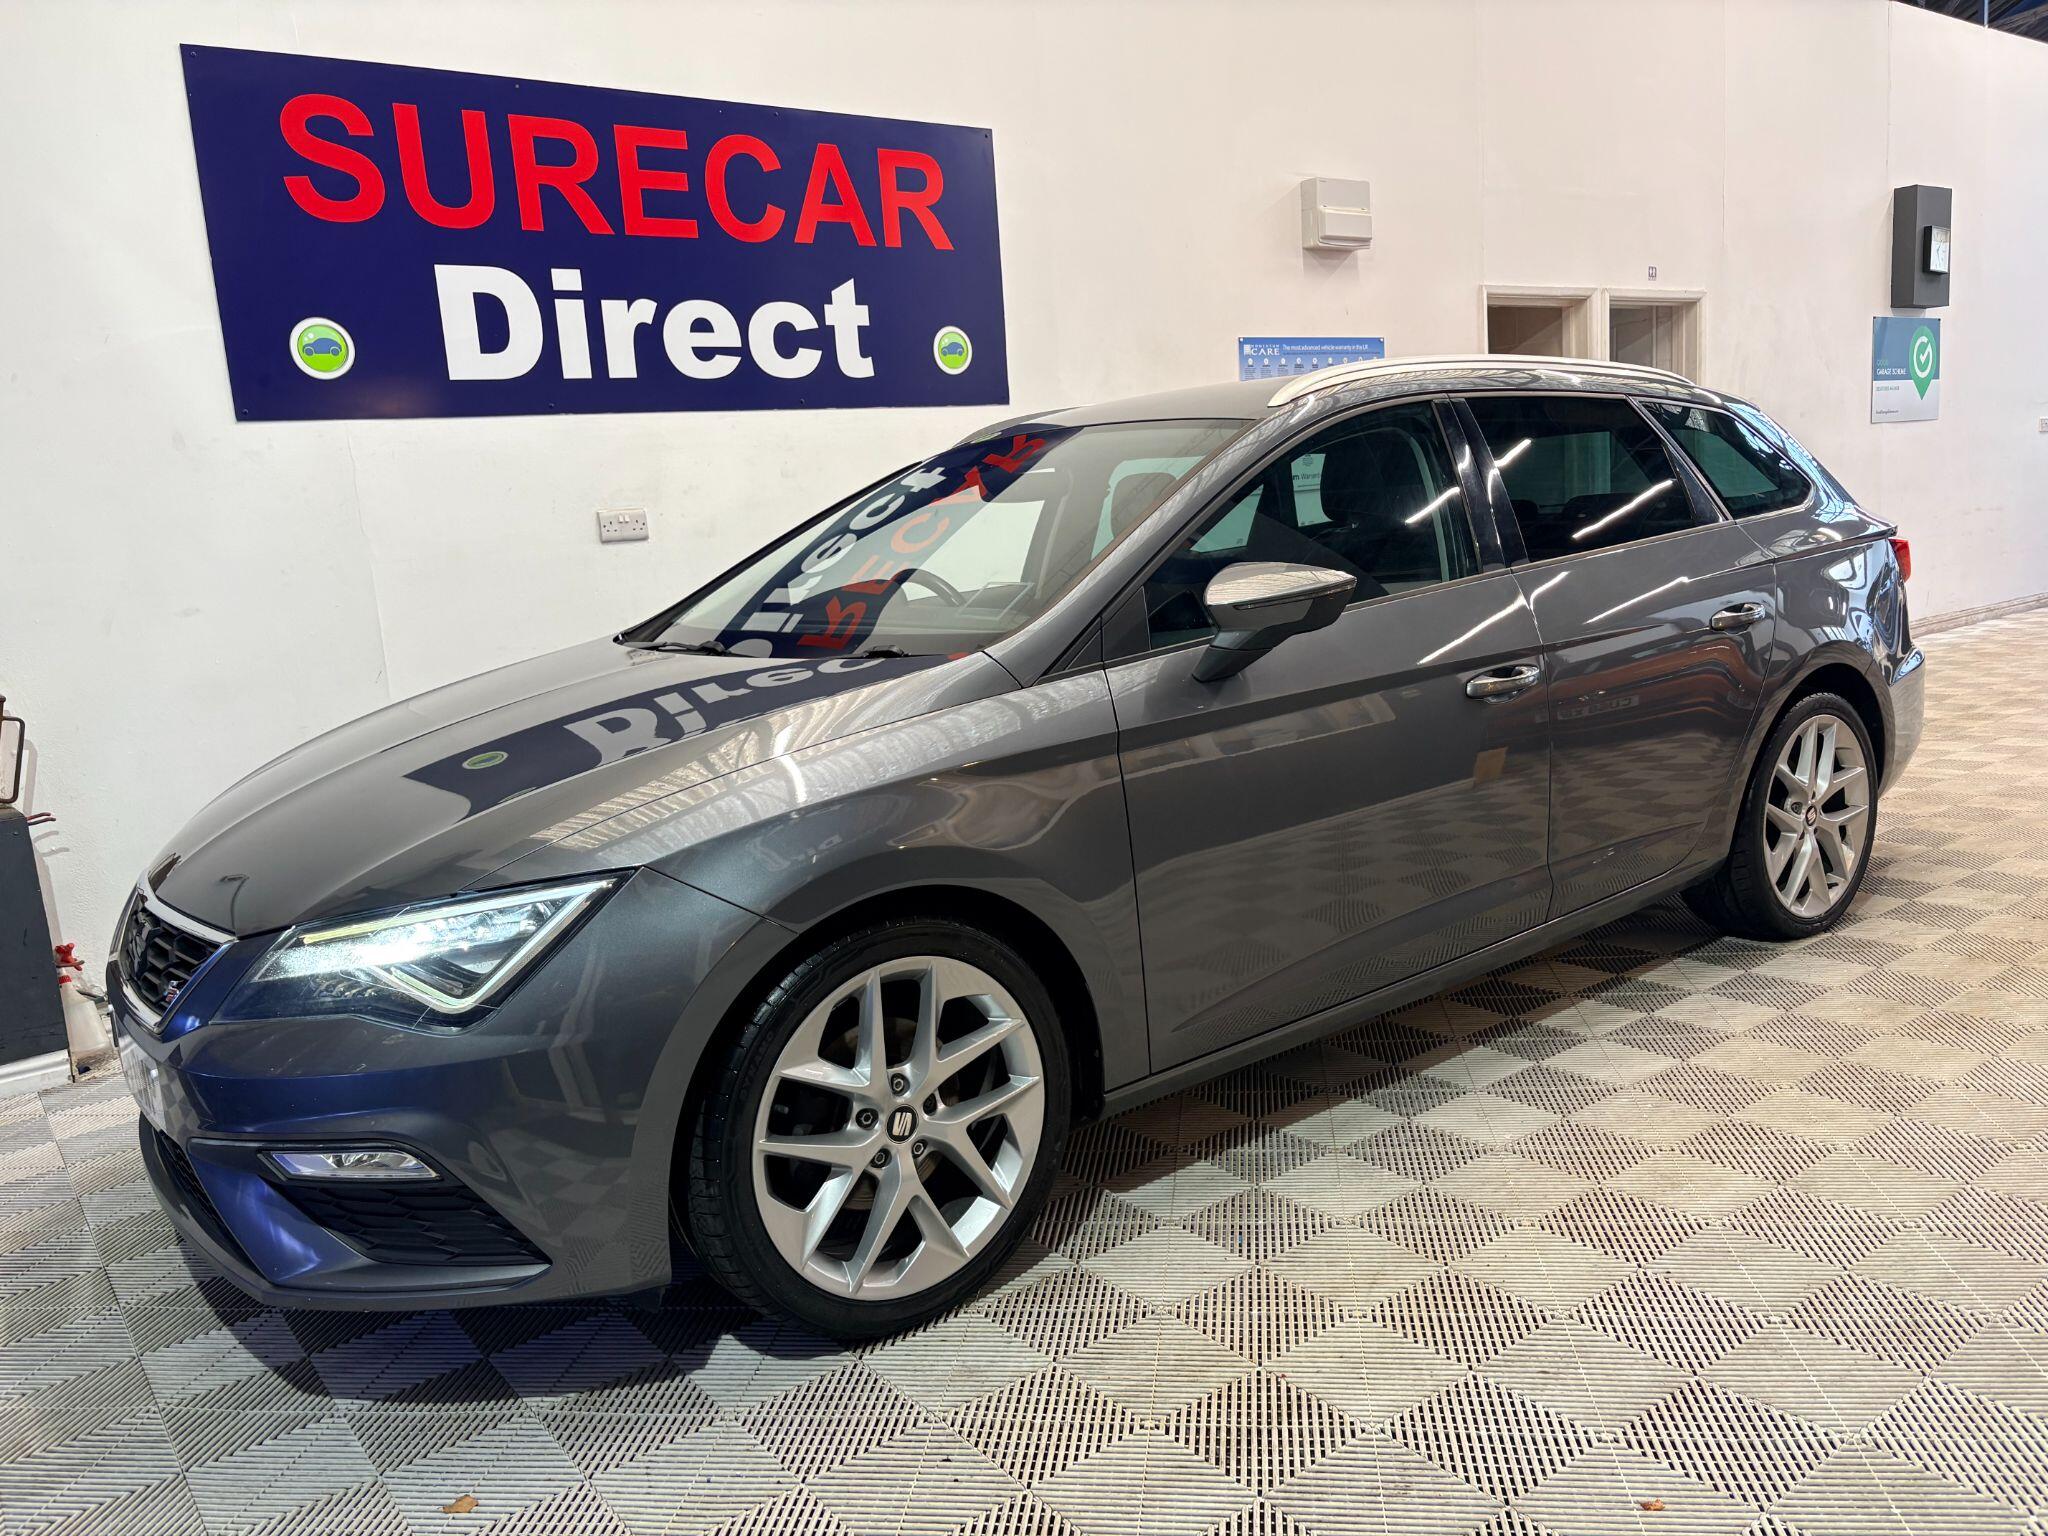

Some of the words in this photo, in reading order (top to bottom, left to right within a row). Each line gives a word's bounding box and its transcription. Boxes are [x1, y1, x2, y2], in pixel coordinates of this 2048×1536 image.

[280, 94, 952, 250] SURECAR
[435, 265, 874, 380] Direct
[1251, 348, 1280, 356] CARE
